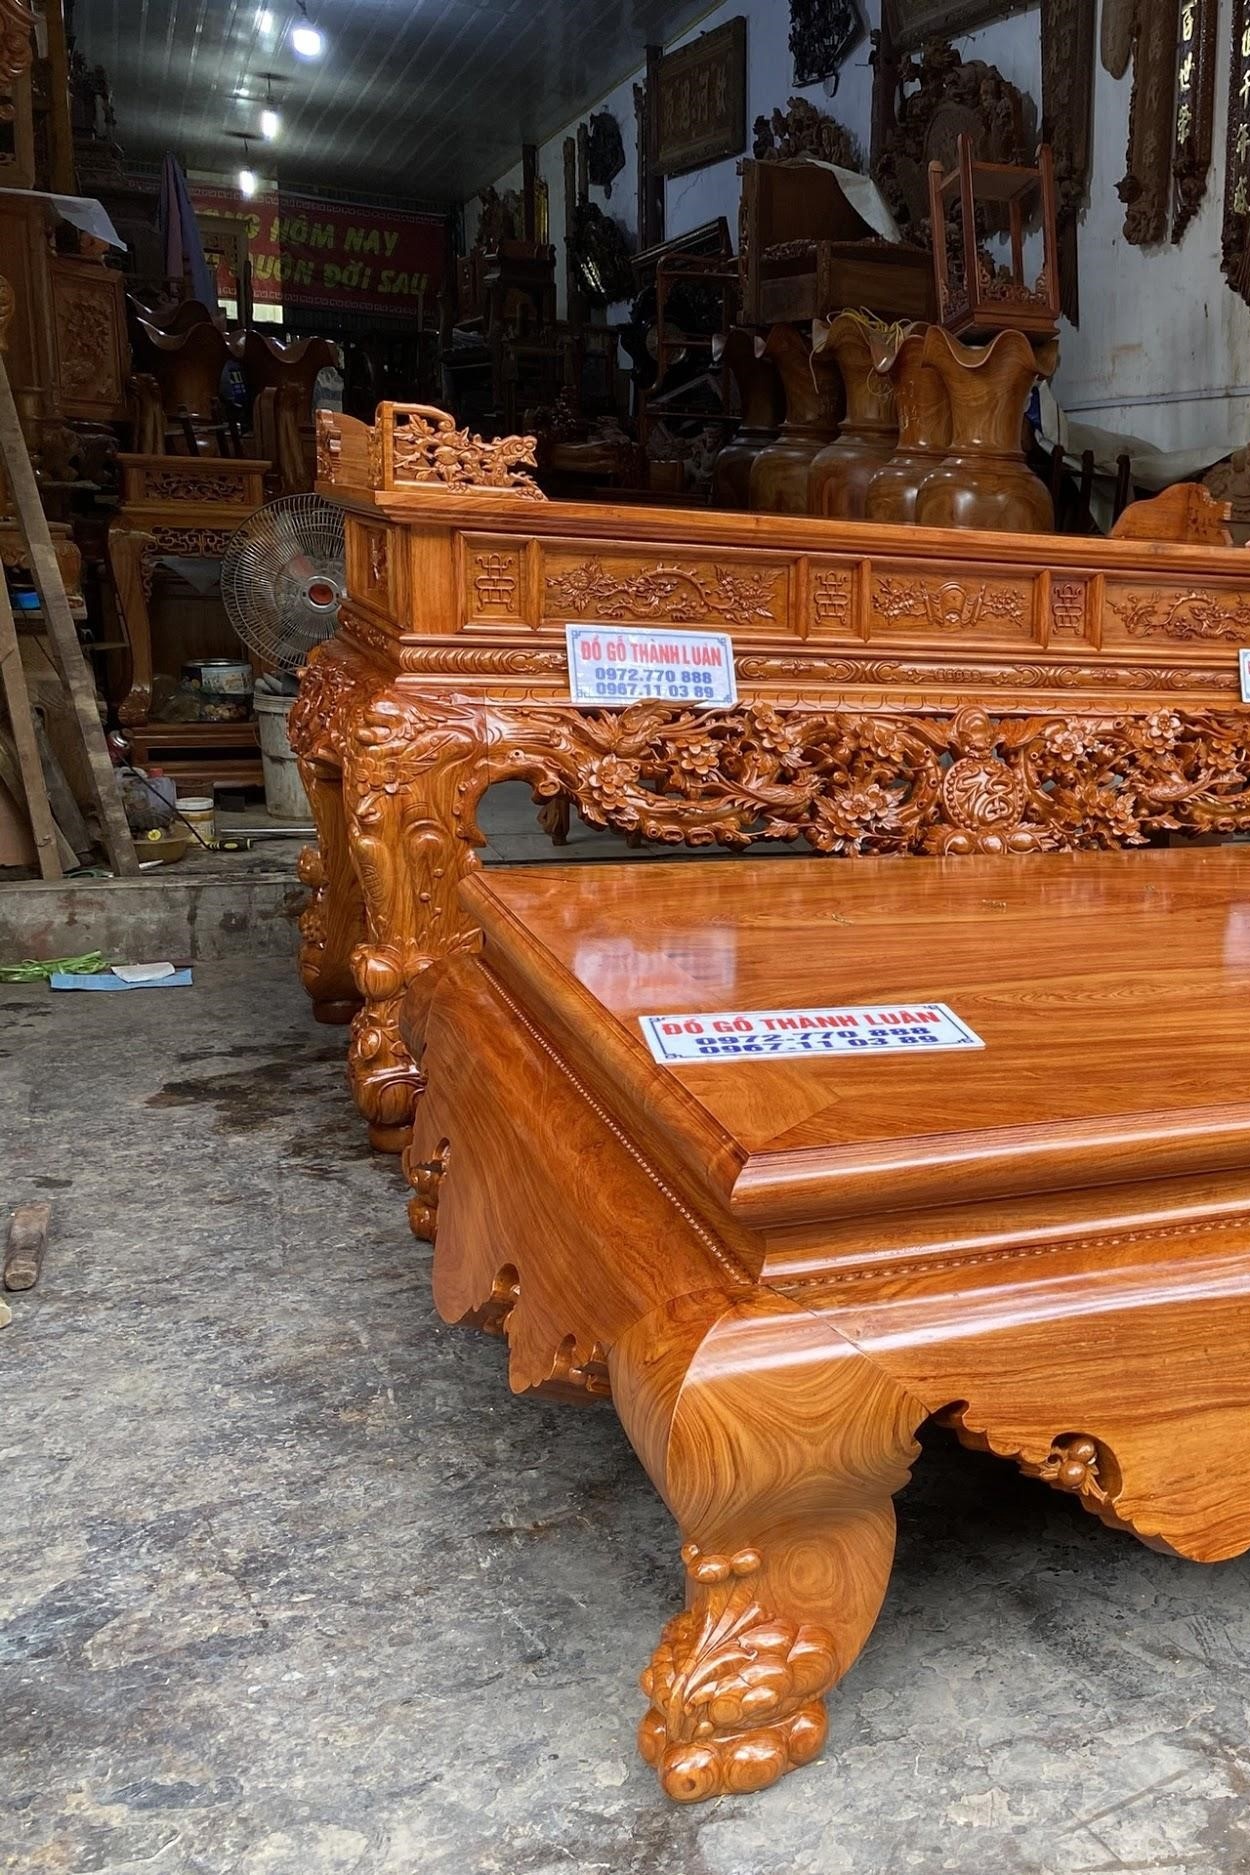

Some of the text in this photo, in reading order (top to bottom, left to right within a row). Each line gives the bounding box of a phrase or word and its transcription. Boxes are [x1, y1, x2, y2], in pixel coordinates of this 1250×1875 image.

[344, 226, 400, 257] NAY
[630, 638, 680, 665] THÀNH
[595, 667, 712, 684] 0972.770 888
[668, 685, 689, 698] 03
[694, 686, 714, 698] 89
[759, 1013, 859, 1031] THÀNH
[695, 1026, 931, 1046] 0972.770 888
[848, 1037, 888, 1047] 03
[898, 1035, 939, 1044] 89
